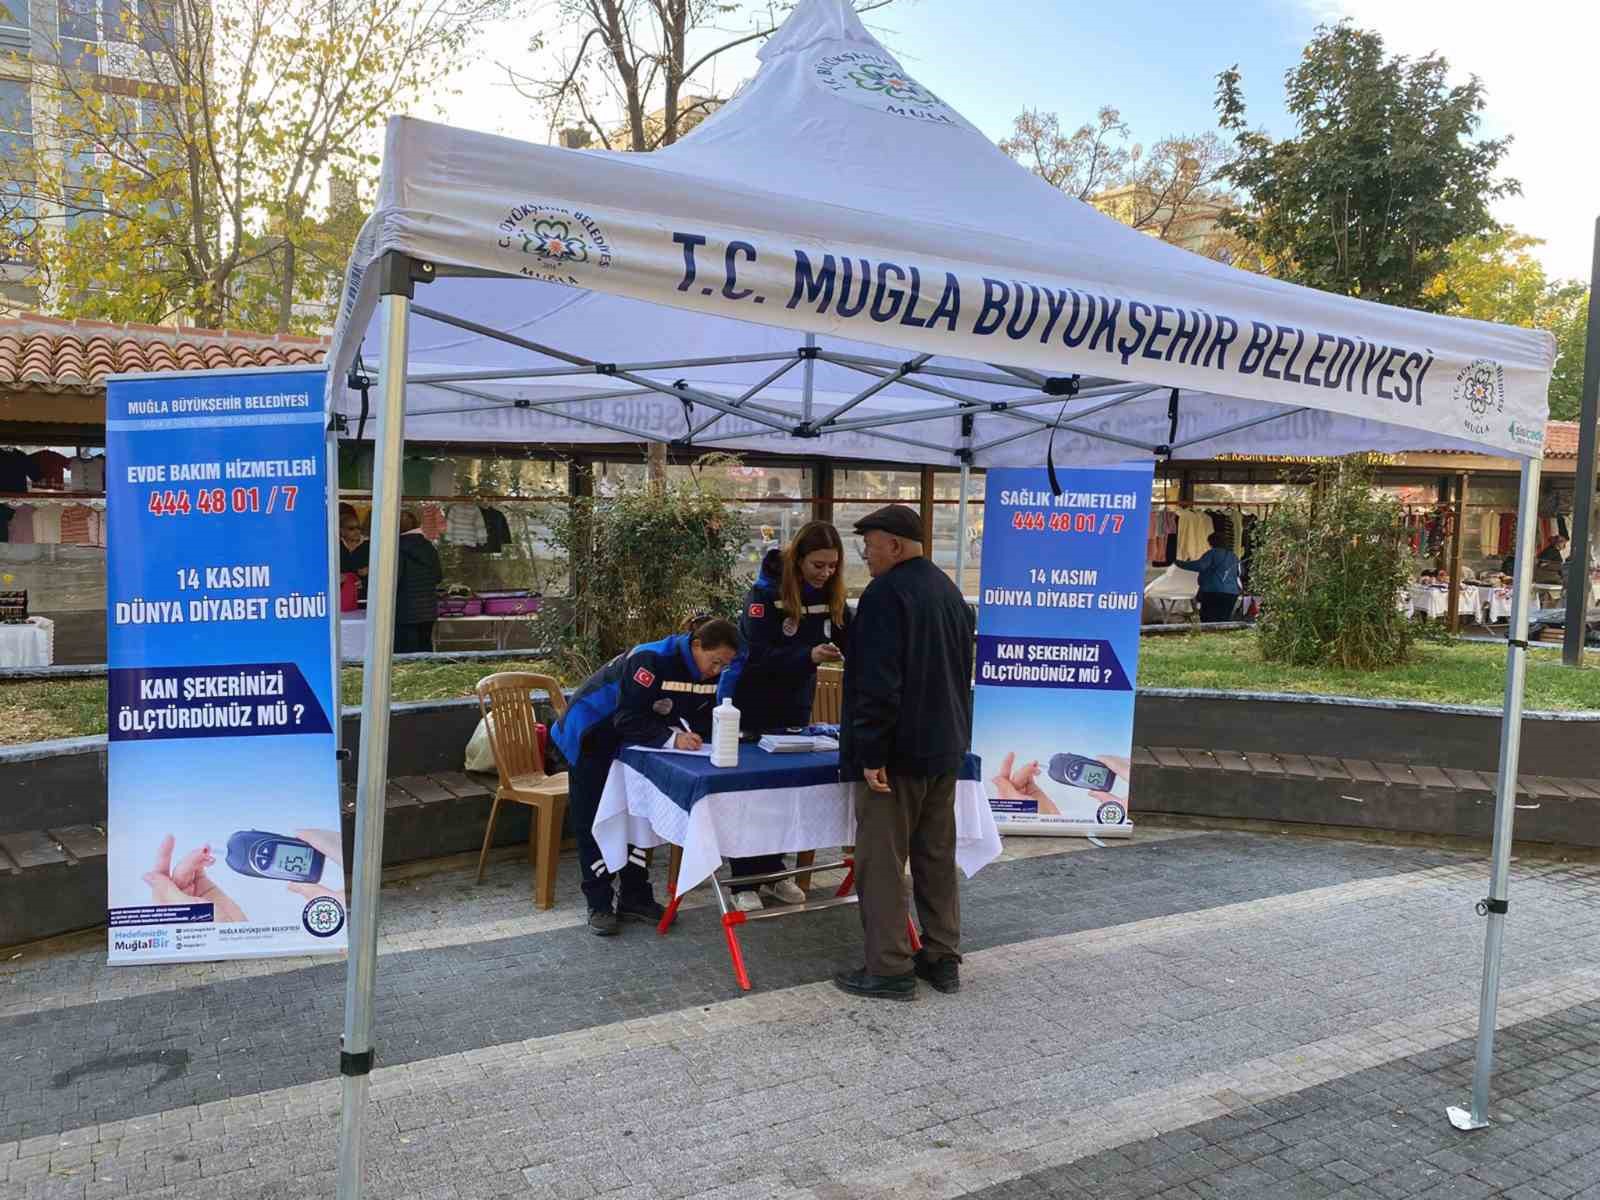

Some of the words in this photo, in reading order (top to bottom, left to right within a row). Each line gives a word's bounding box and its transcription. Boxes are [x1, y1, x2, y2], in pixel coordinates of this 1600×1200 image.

[672, 231, 766, 304] T.C.
[1237, 320, 1435, 406] BELEDİYESİ
[128, 398, 168, 415] MUĞLA
[172, 394, 241, 412] BÜYÜKŞEHİR
[245, 391, 309, 409] BELEDİYESİ
[128, 466, 166, 483] EVDE
[170, 463, 220, 482] BAKIM
[226, 456, 317, 480] HİZMETLERİ
[149, 490, 190, 516] 444
[198, 488, 225, 514] 48
[231, 488, 259, 514] 01
[282, 486, 298, 512] 7
[1000, 488, 1050, 507] SAĞLIK
[1054, 490, 1137, 510] HİZMETLERİ
[1012, 511, 1044, 531] 444
[1049, 512, 1071, 532] 48
[1075, 513, 1096, 532] 01
[1112, 514, 1125, 534] 7
[177, 568, 200, 590] 14
[206, 565, 270, 589] KASIM
[1029, 568, 1047, 584] 14
[1051, 569, 1098, 586] KASIM
[116, 598, 183, 624] DÜNYA
[189, 595, 269, 622] DİYABET
[275, 592, 327, 619] GÜNÜ
[985, 586, 1032, 607] DÜNYA
[1036, 588, 1094, 609] DİYABET
[1097, 591, 1138, 610] GÜNÜ
[997, 643, 1025, 660] KAN
[1028, 643, 1100, 662] ŞEKERİNİZİ
[982, 661, 1075, 683] ÖLÇTÜRDÜNÜZ
[1078, 663, 1100, 683] MÜ
[1103, 668, 1112, 684] ?
[140, 677, 178, 700] KAN
[183, 669, 284, 701] ŞEKERİNİZİ
[118, 702, 252, 733] ÖLÇTÜRDÜNÜZ
[257, 700, 288, 726] MÜ
[292, 703, 305, 725] ?
